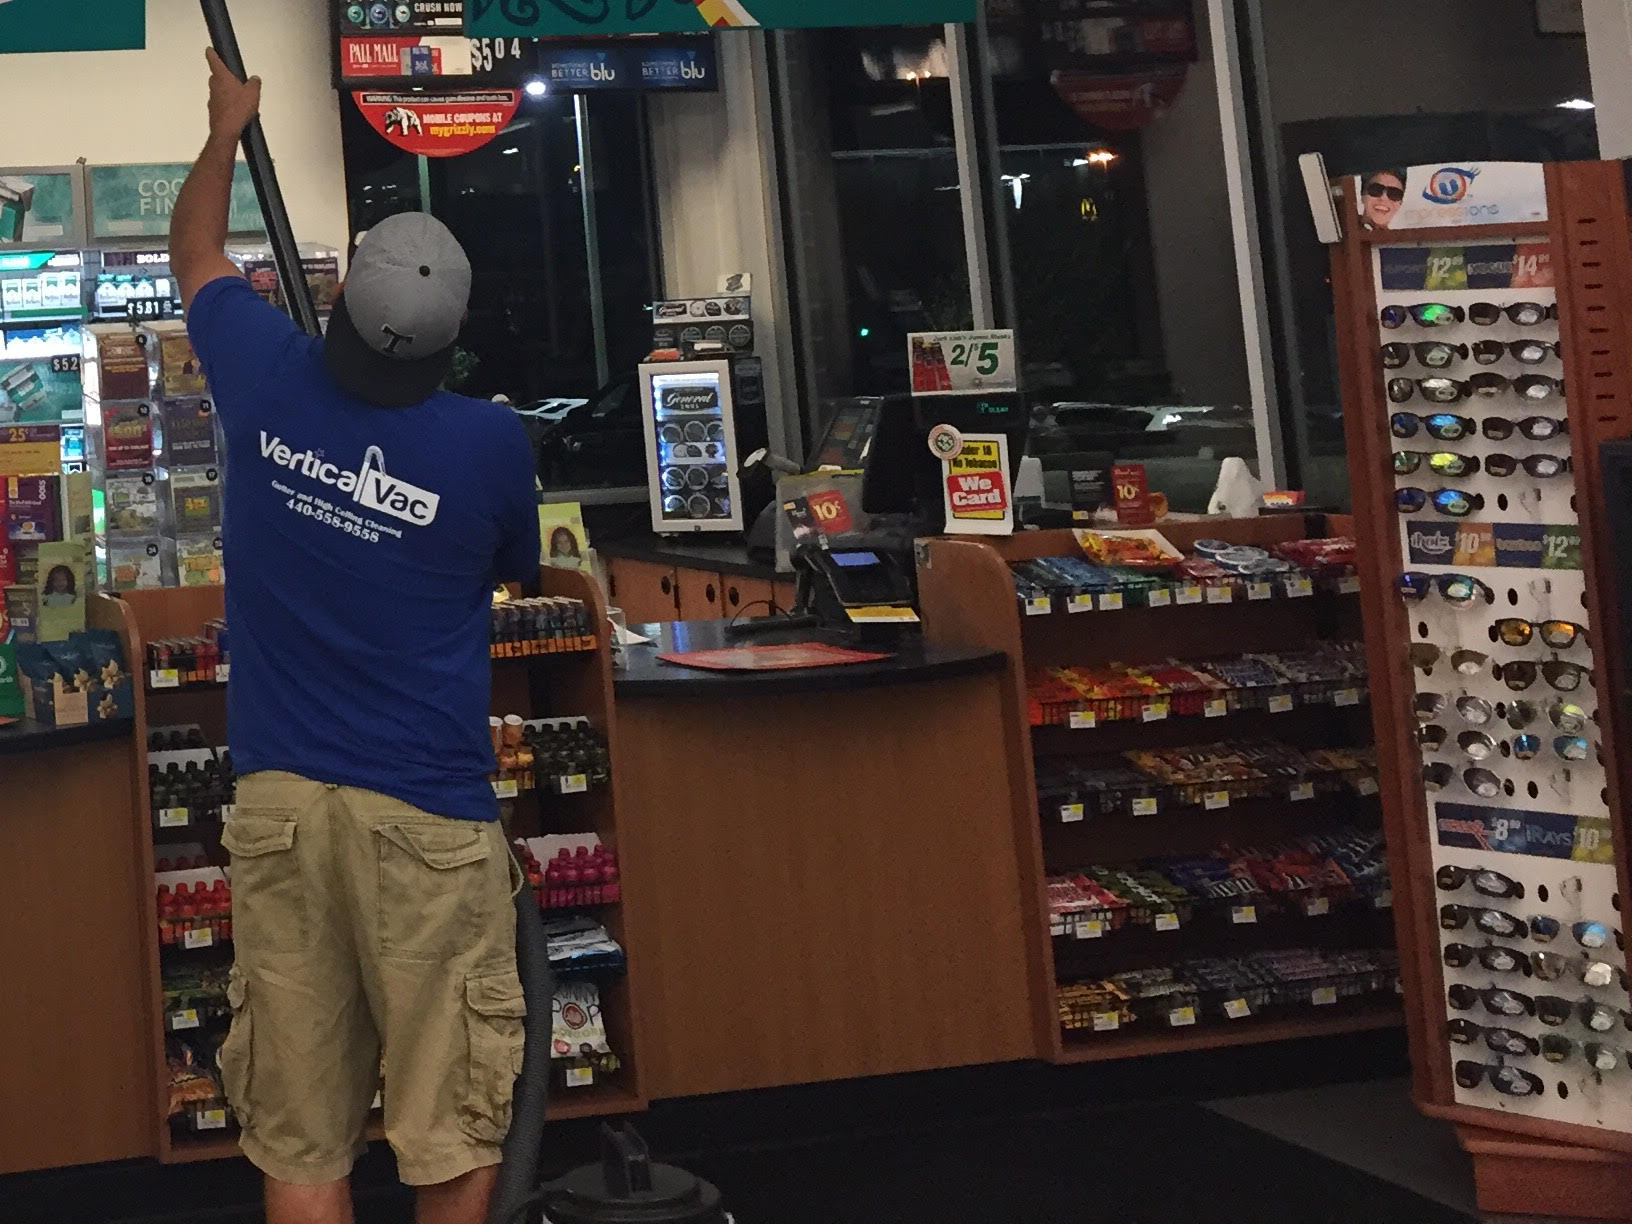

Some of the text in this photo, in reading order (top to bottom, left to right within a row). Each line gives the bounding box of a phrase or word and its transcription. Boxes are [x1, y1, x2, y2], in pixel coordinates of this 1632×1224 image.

[414, 2, 463, 13] CRUSH NOW
[349, 42, 399, 63] PALL MALL
[590, 62, 615, 80] blu
[681, 60, 705, 80] blu
[422, 112, 503, 124] MOBILE COUPONS AT
[430, 124, 496, 137] mygrizzly.com
[381, 323, 416, 354] T
[52, 356, 79, 371] $52
[664, 391, 714, 407] General
[958, 476, 993, 492] We
[374, 476, 429, 520] Vac
[952, 489, 1002, 506] Card
[286, 498, 379, 543] 440-558-9558
